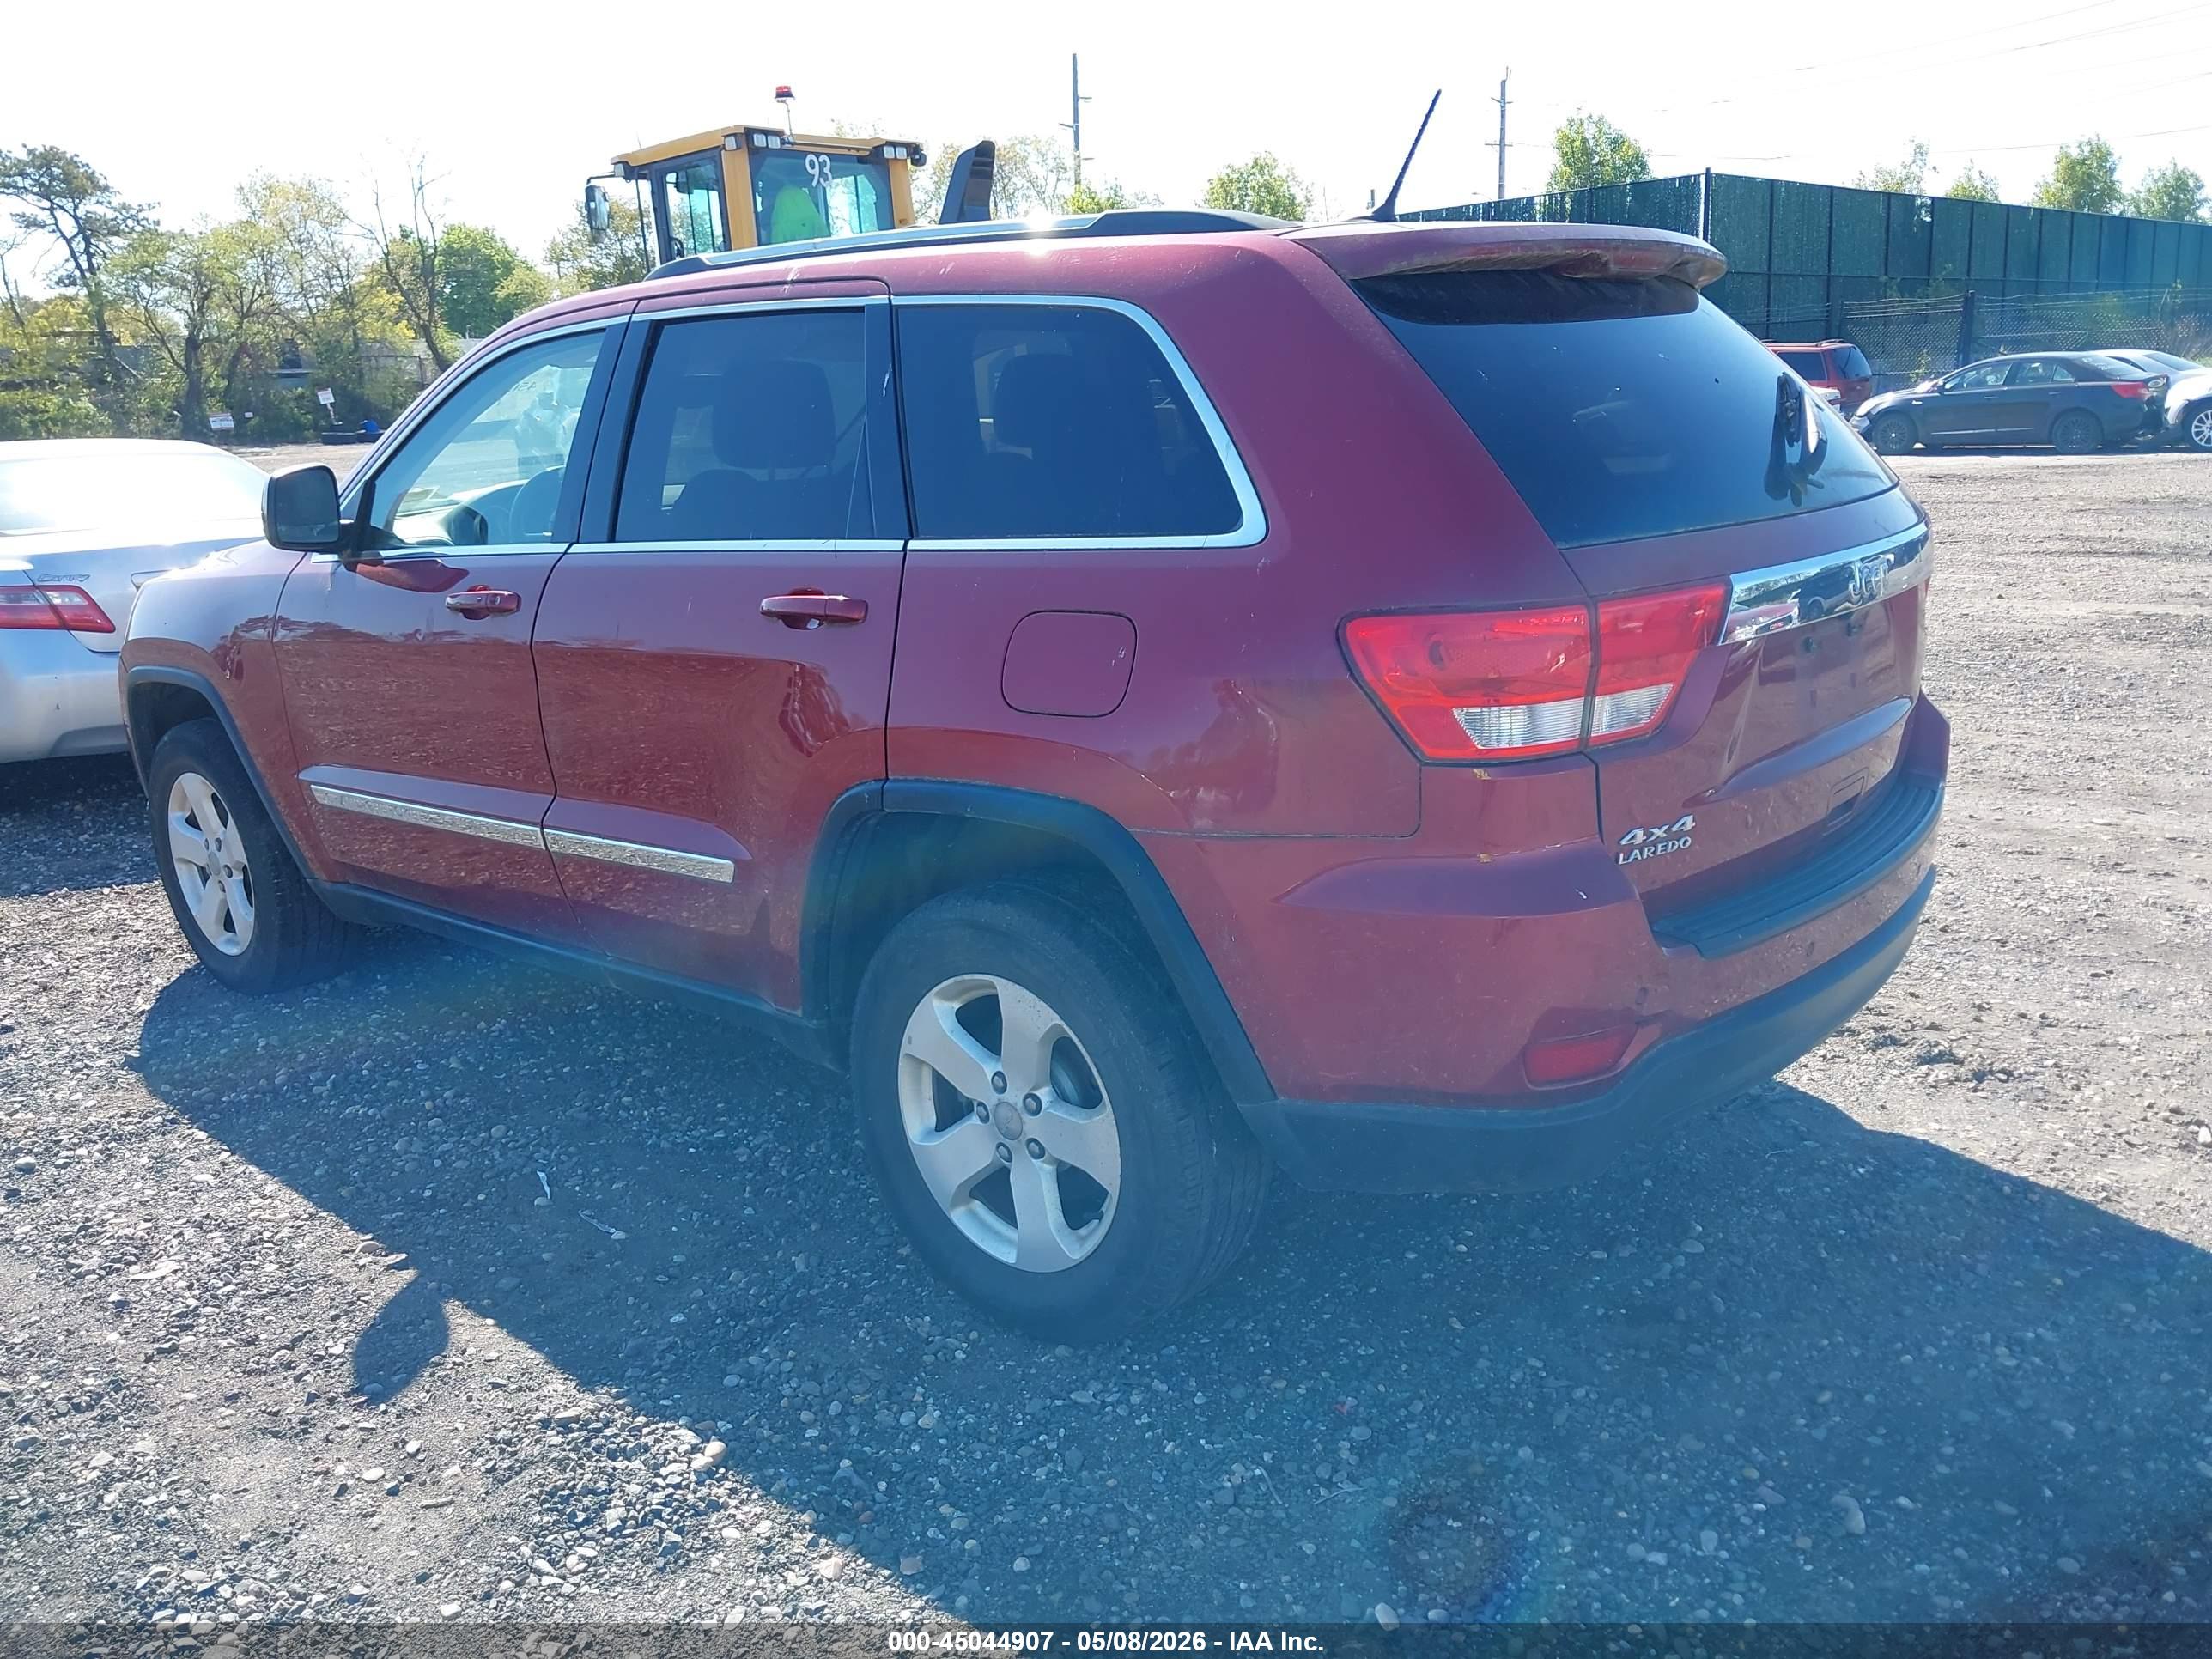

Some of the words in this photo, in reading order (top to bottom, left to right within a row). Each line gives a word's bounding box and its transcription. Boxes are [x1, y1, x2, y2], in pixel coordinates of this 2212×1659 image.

[805, 154, 833, 188] 93
[1848, 553, 1896, 600] Jeep
[1618, 836, 1692, 865] LAREDO
